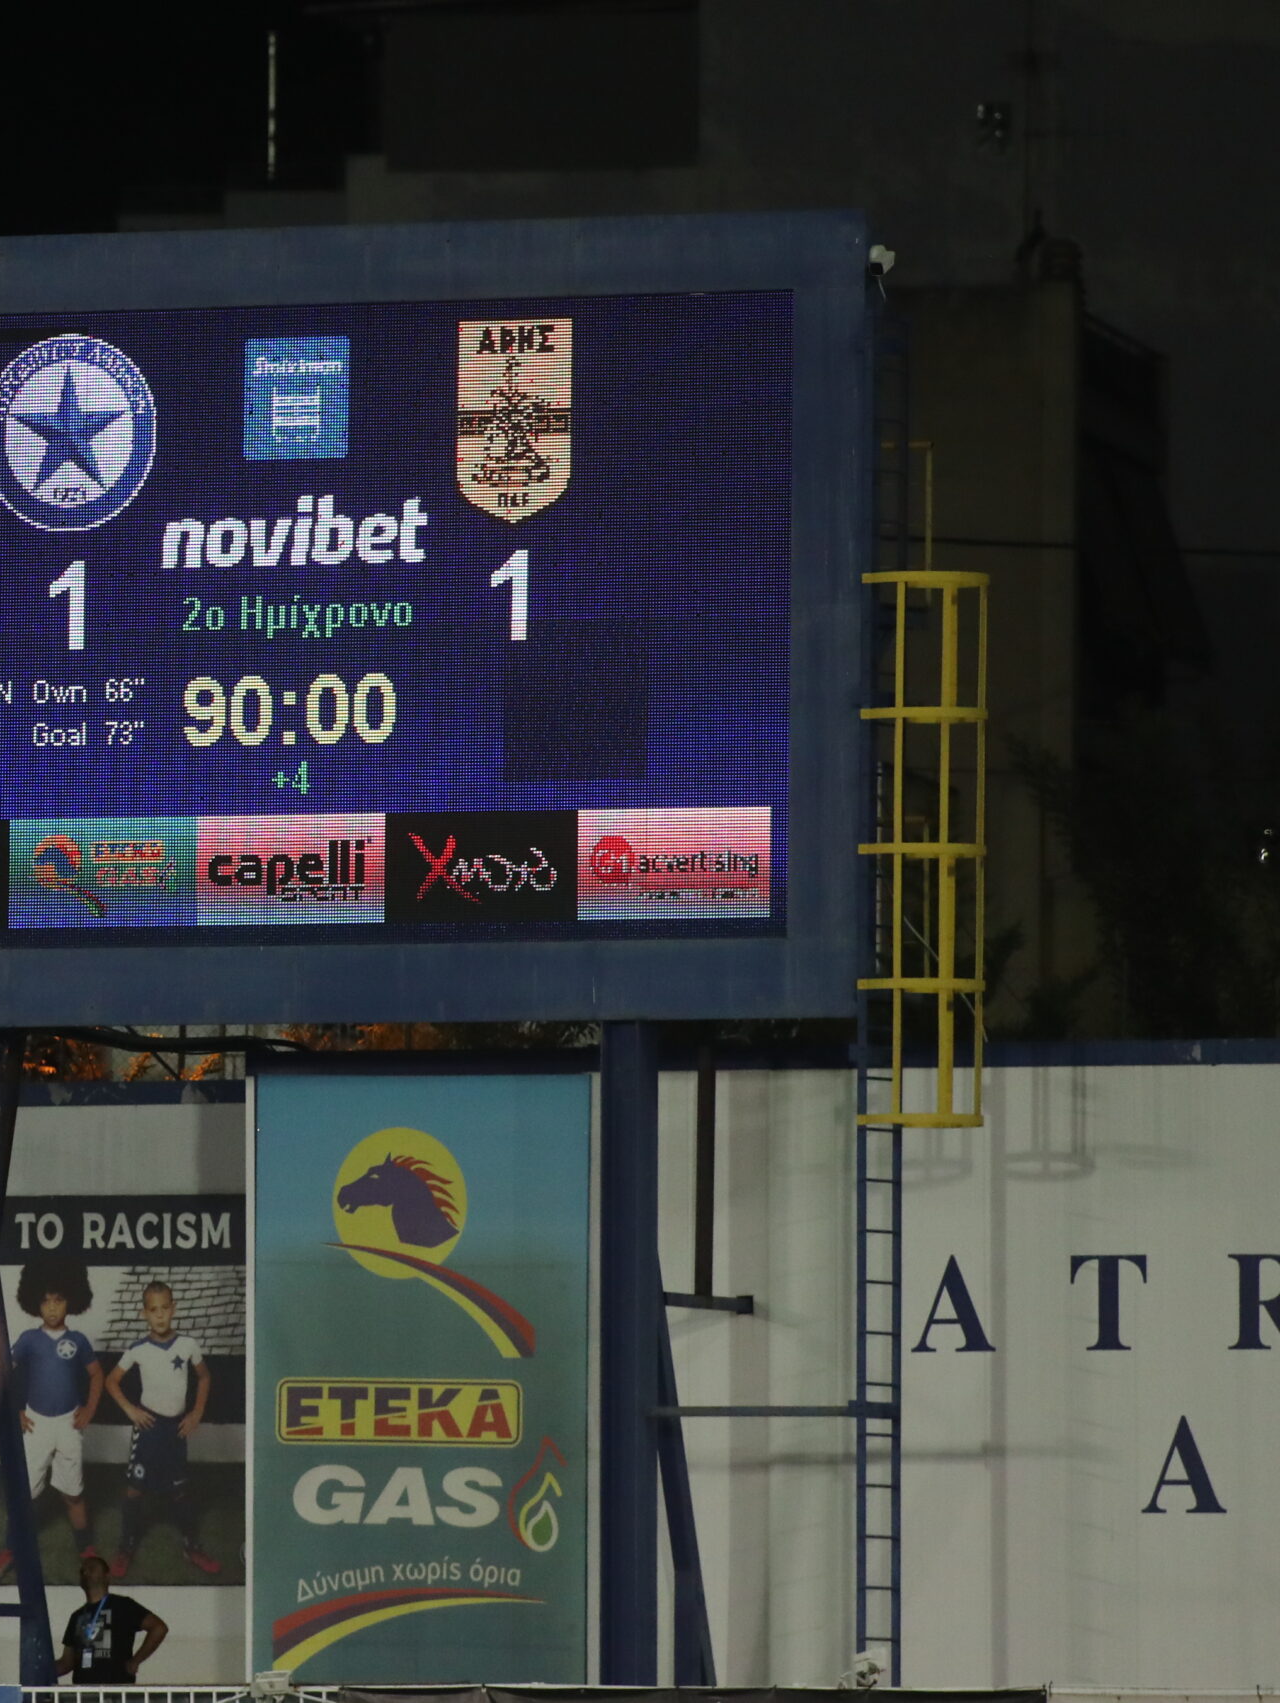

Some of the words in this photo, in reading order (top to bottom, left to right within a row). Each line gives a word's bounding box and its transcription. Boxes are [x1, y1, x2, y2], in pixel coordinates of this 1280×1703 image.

[476, 325, 555, 354] ΑΡΗΣ
[161, 495, 428, 569] novibet
[49, 560, 86, 651] 1
[240, 594, 413, 639] Ημίχρονο
[490, 549, 529, 641] 1
[33, 680, 87, 703] Own
[183, 673, 396, 747] 90:00
[33, 722, 87, 746] Goal
[272, 761, 310, 794] +4
[208, 839, 366, 896] capelli
[14, 1212, 64, 1249] TO
[82, 1212, 232, 1250] RACISM
[286, 1386, 513, 1439] ETEKA
[1141, 1415, 1228, 1514] A
[293, 1464, 503, 1528] GAS
[297, 1564, 384, 1603] Δύναμη
[392, 1555, 462, 1584] χωρίς
[470, 1557, 521, 1588] όρια
